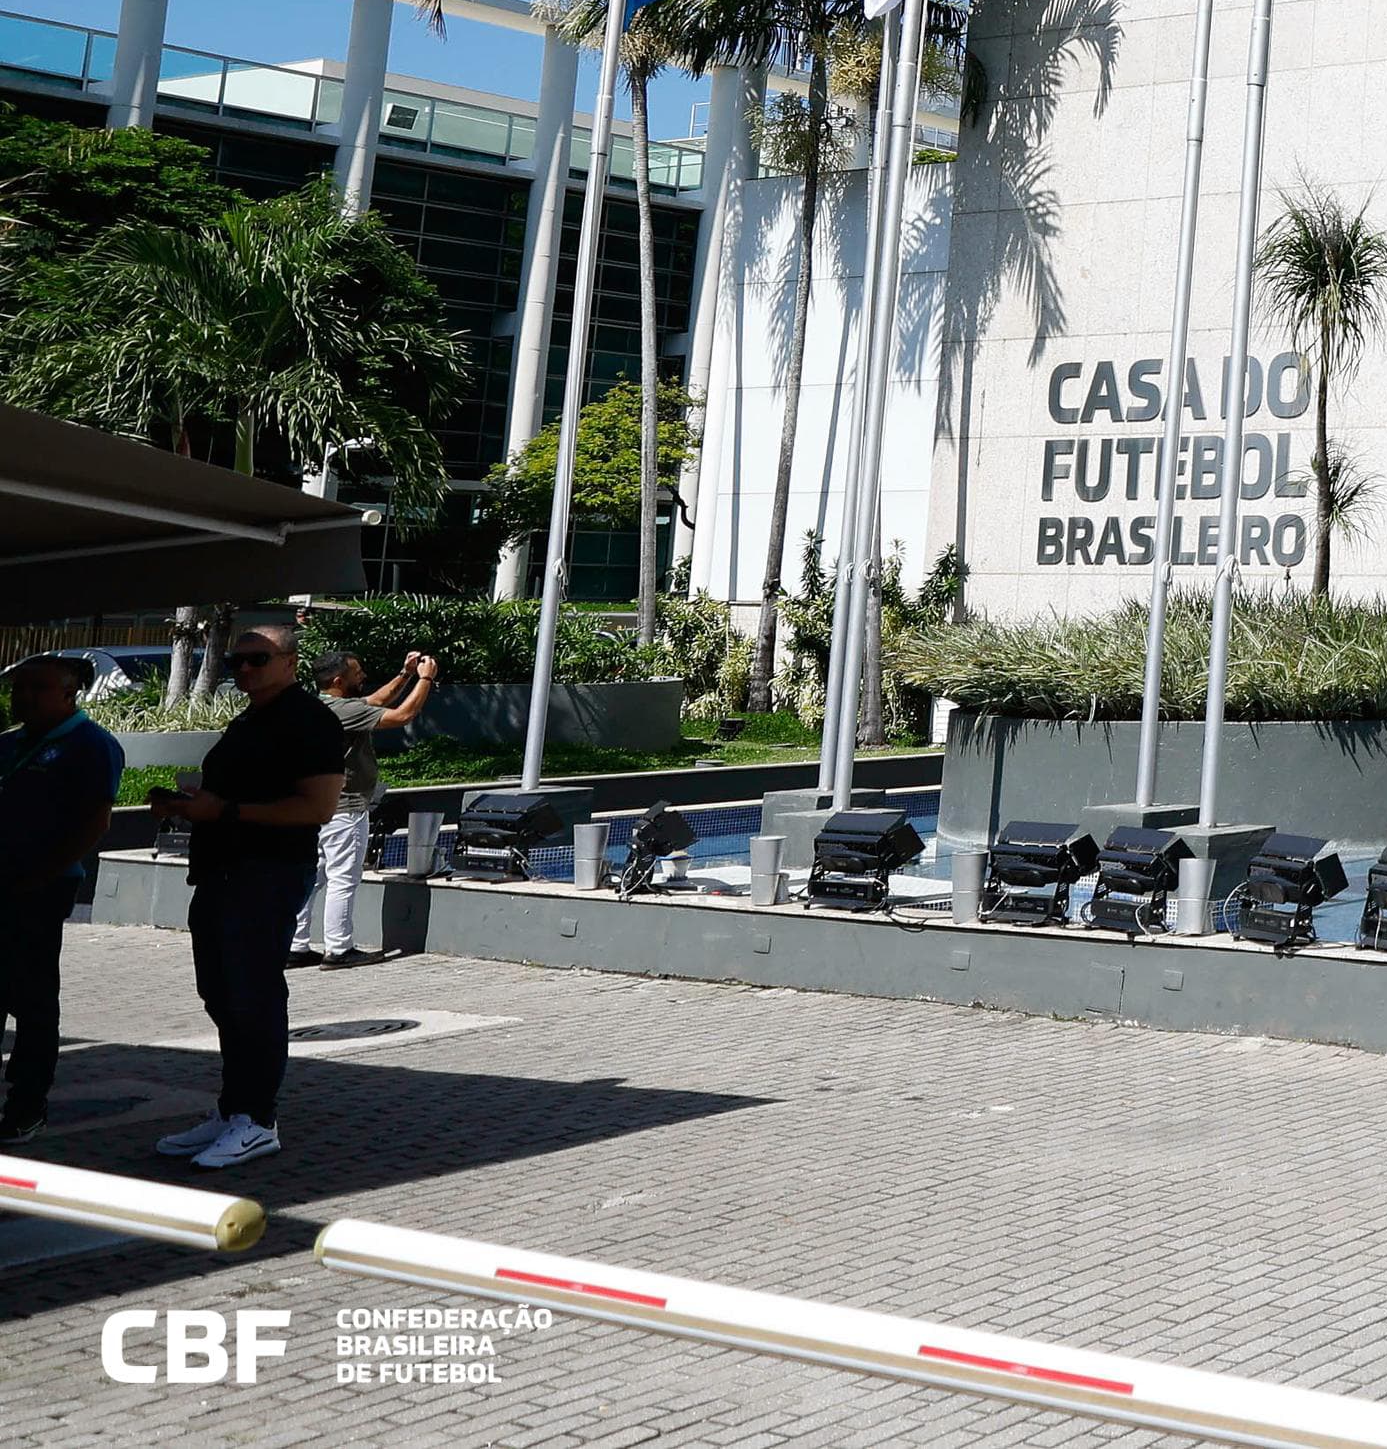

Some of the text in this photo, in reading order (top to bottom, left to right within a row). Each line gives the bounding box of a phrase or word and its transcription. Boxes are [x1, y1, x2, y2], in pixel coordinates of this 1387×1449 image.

[1048, 351, 1312, 425] CASA DO
[1041, 432, 1307, 503] FUTEBOL
[1036, 514, 1307, 568] BRASLERO
